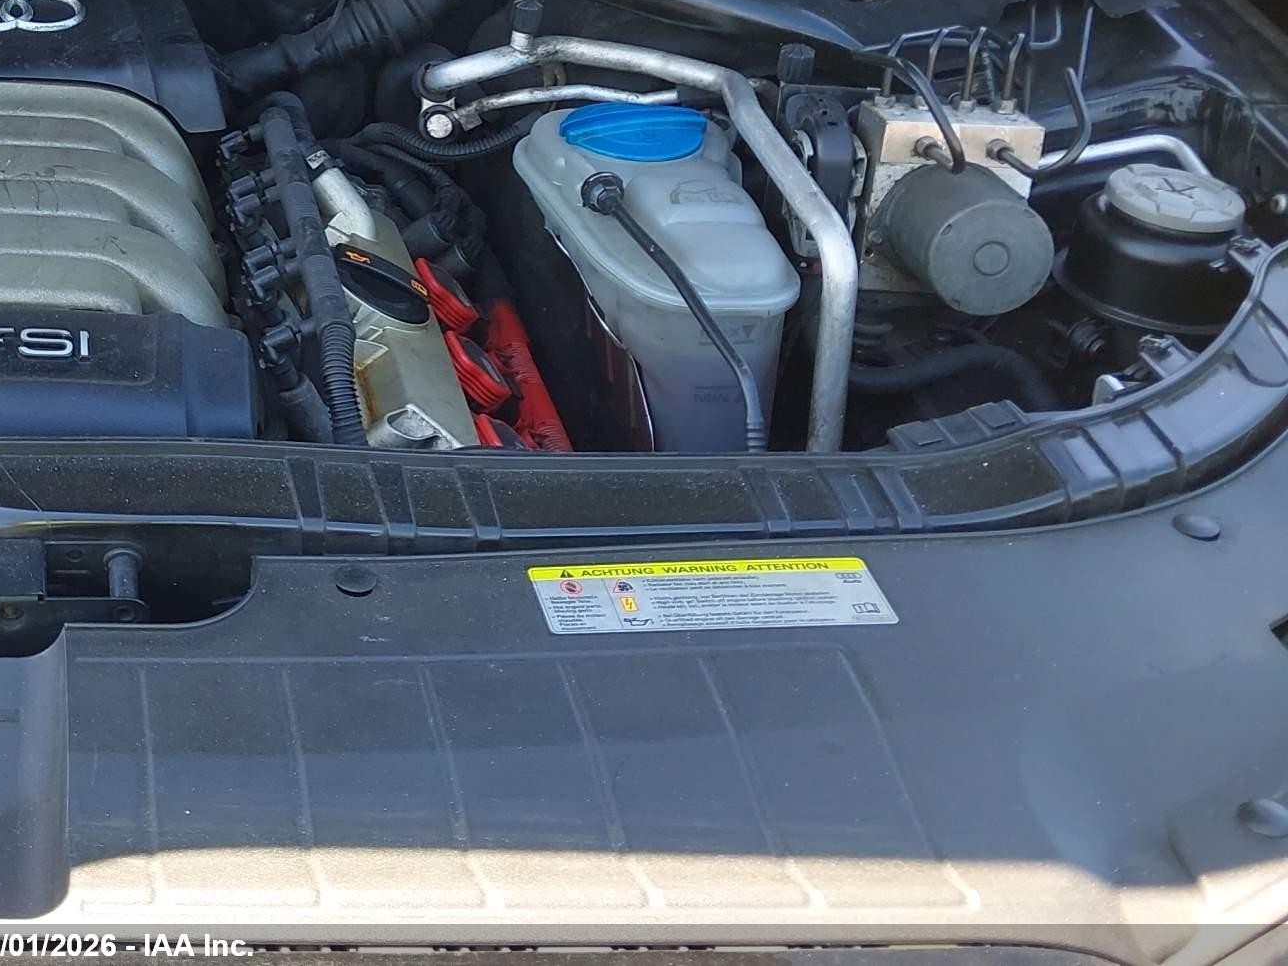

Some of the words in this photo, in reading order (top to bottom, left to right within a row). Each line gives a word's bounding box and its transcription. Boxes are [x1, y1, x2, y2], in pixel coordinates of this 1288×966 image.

[580, 567, 655, 578] ACHTUNG
[662, 564, 737, 574] WARNING
[746, 561, 830, 571] ATTENTION
